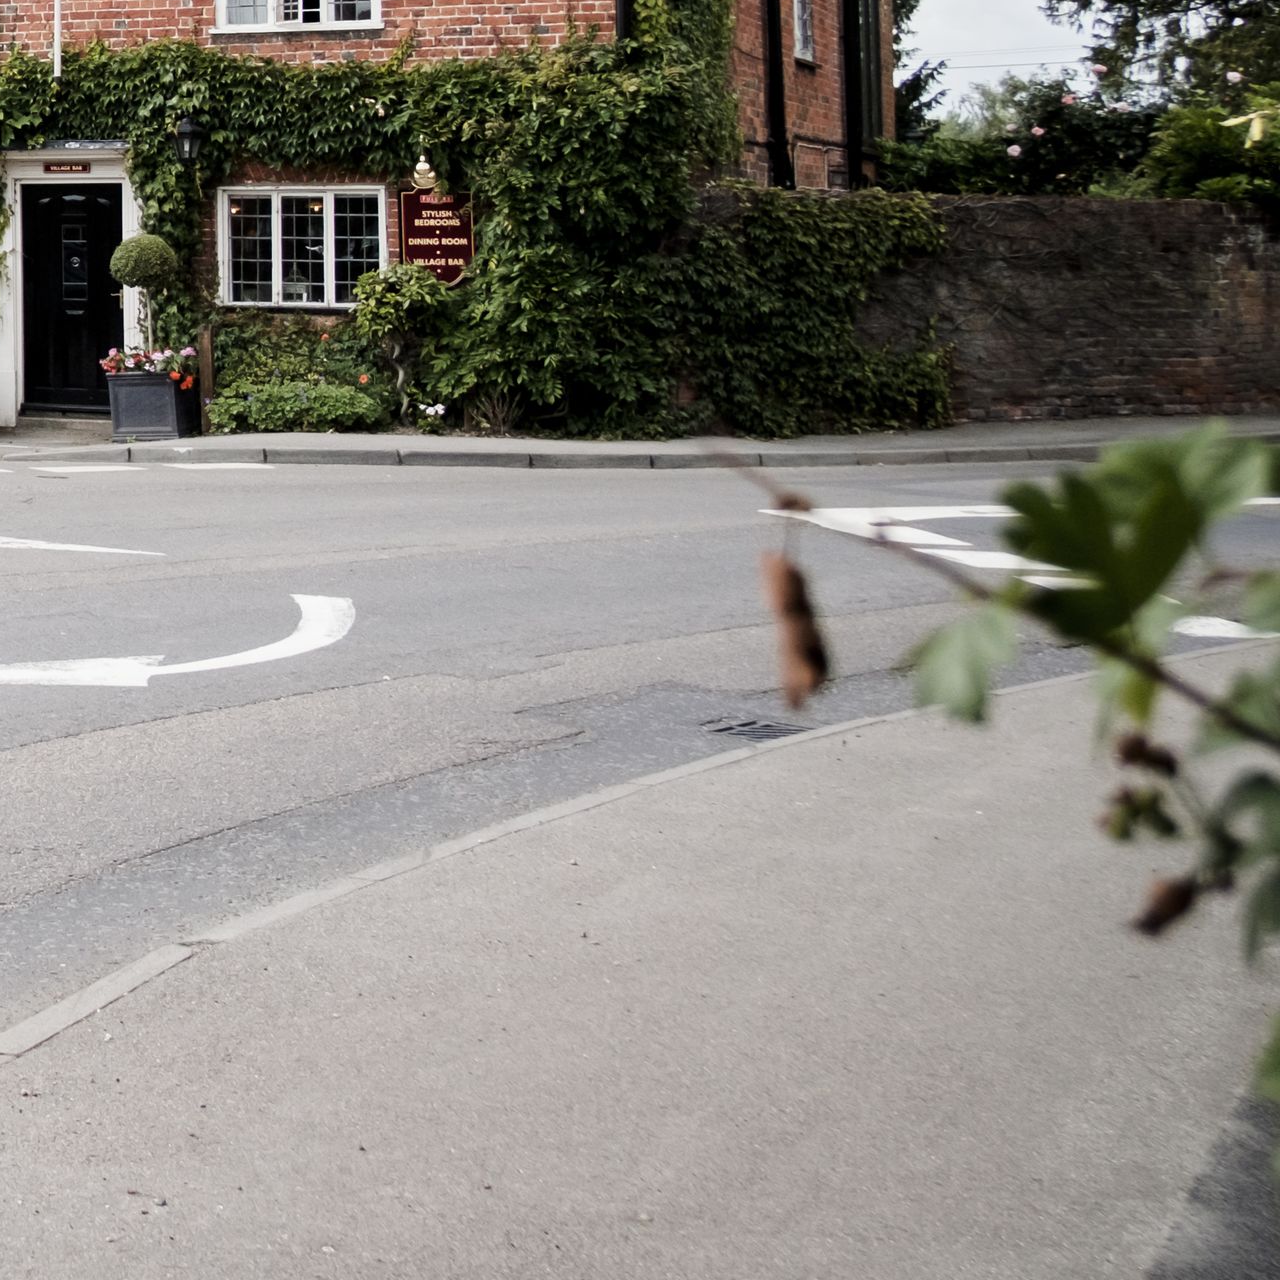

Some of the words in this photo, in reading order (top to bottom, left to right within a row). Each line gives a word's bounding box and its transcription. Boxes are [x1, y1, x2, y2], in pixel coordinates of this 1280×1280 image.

[422, 210, 453, 218] STYLISH
[414, 218, 461, 227] BEDROOMS
[408, 238, 439, 246] DINING
[441, 238, 468, 246] ROOM
[413, 258, 446, 266] VILLAGE
[448, 258, 465, 266] BAR
